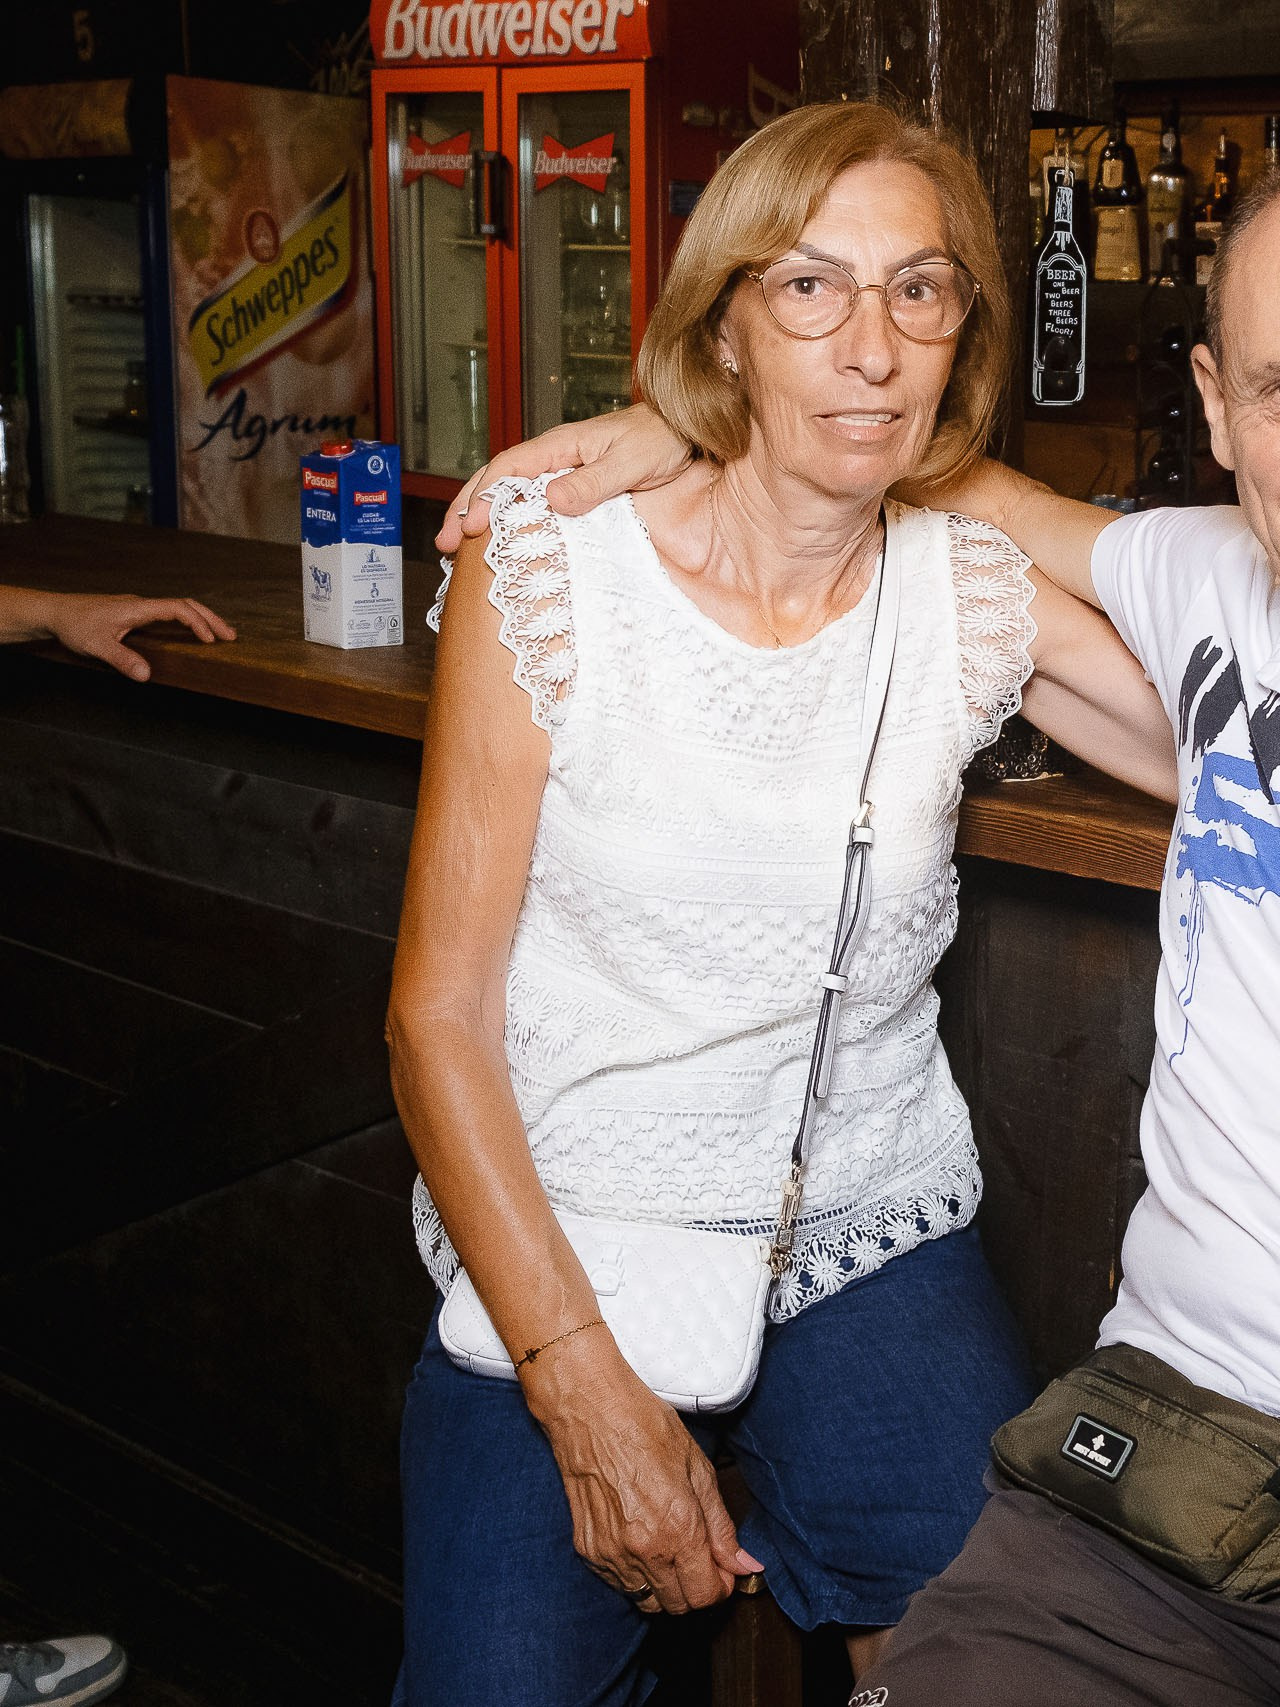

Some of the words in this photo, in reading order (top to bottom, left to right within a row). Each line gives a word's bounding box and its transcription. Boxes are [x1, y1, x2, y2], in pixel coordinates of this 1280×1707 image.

[382, 0, 635, 59] Budweiser
[533, 149, 618, 174] Budweiser
[1046, 269, 1076, 281] BEER
[205, 225, 339, 366] Schweppes
[1061, 287, 1080, 295] BEER
[1050, 300, 1074, 308] BEERS
[1048, 309, 1071, 317] THREE
[1055, 316, 1079, 325] BEERS
[191, 387, 357, 461] Agrum
[305, 471, 337, 489] Pascual
[355, 492, 385, 503] Pascual
[306, 507, 337, 522] ENTERA
